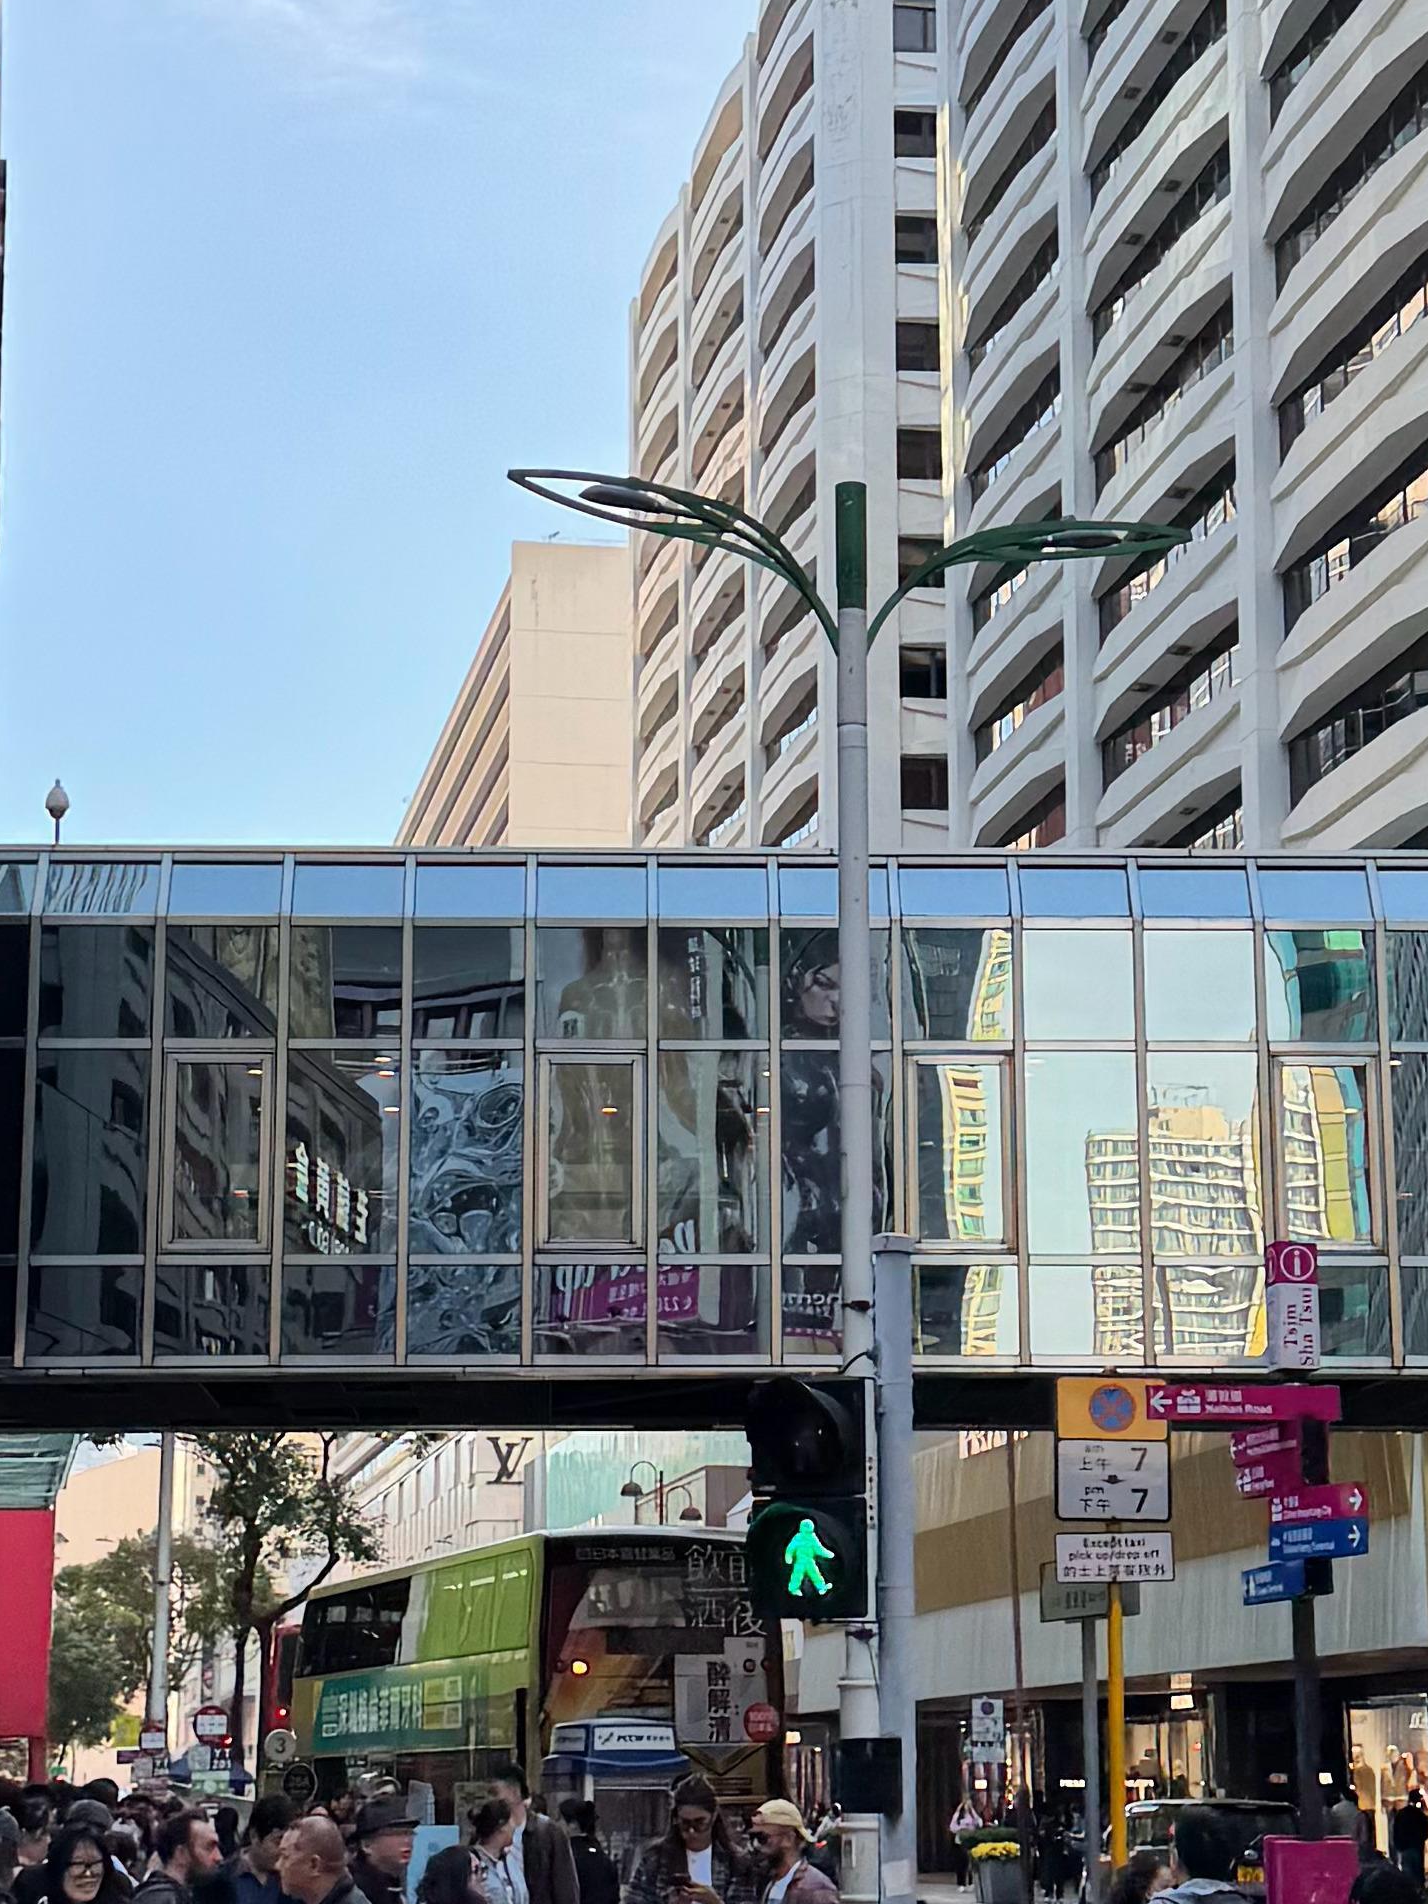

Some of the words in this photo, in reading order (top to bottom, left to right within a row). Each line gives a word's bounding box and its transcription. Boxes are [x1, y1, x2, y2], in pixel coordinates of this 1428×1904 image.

[1283, 1303, 1298, 1349] Tsim
[1130, 1447, 1148, 1471] 7
[1131, 1488, 1149, 1513] 7
